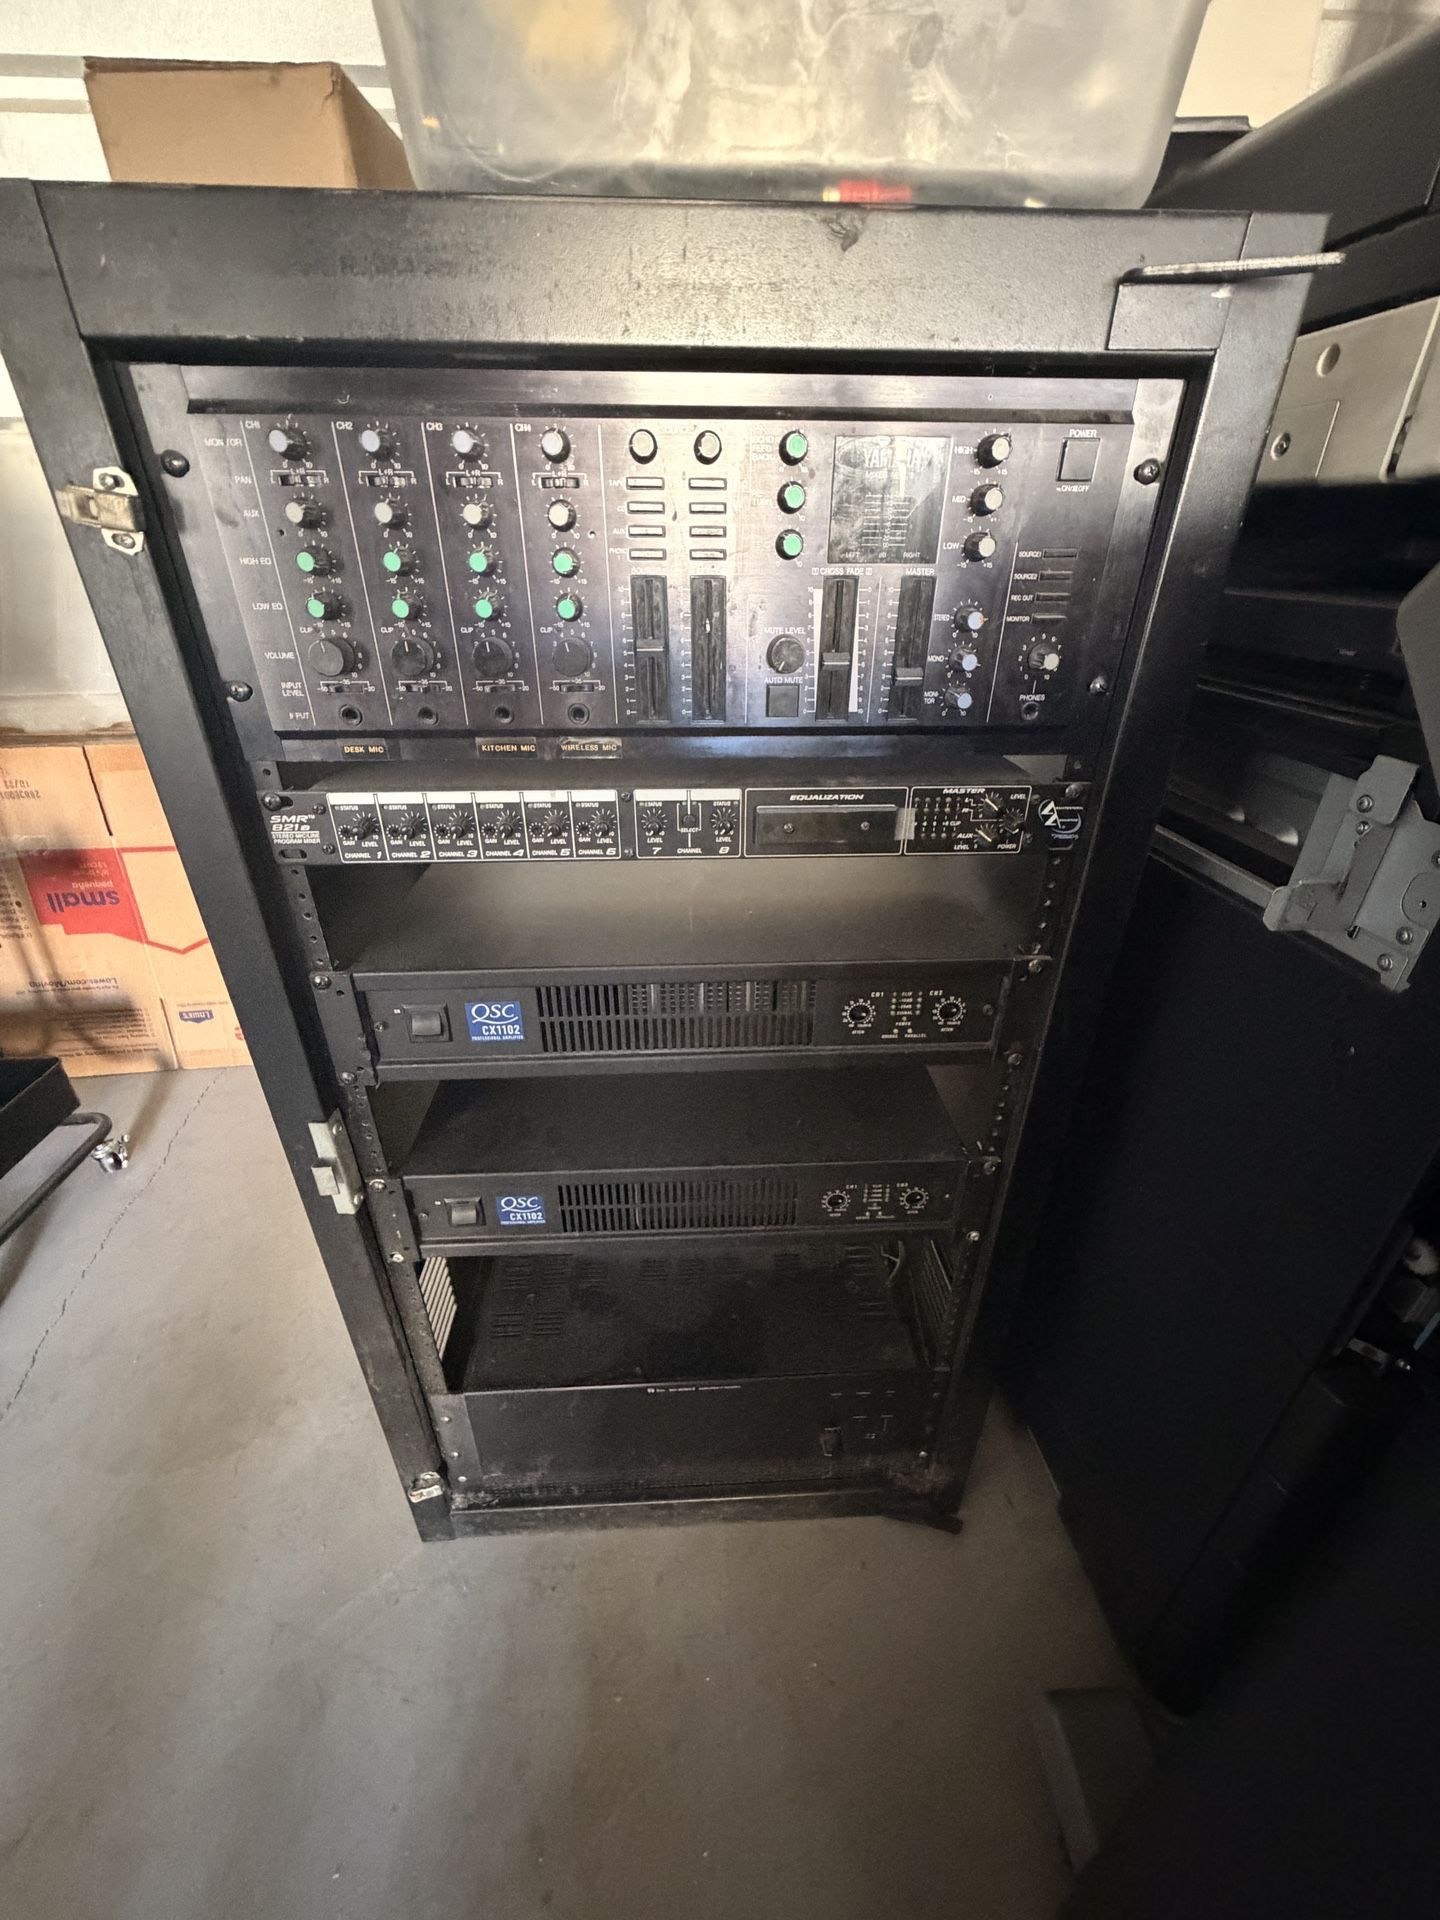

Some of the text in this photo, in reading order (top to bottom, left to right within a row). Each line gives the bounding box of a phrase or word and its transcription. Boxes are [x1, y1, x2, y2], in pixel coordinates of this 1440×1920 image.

[245, 421, 261, 429] CH1
[336, 422, 353, 430] CH2
[426, 422, 443, 431] CH3
[515, 424, 531, 432] CH4
[1069, 429, 1097, 438] POWER
[234, 476, 252, 484] PAN
[240, 557, 259, 565] HIGH
[272, 603, 283, 611] EQ
[265, 652, 295, 660] VOLUME
[344, 746, 384, 754] DESK MIC
[481, 744, 517, 752] KITCHEN
[561, 744, 617, 752] WIRELESS MIC
[420, 850, 431, 858] 2
[467, 850, 477, 858] 3
[513, 849, 524, 857] 4
[560, 848, 571, 856] 5
[606, 848, 616, 856] 6
[652, 847, 662, 855] 7
[719, 846, 730, 855] 8
[376, 851, 382, 859] 1
[47, 890, 120, 913] small
[471, 1003, 519, 1024] QSC
[482, 1025, 520, 1035] CX1102
[501, 1196, 541, 1213] QSC
